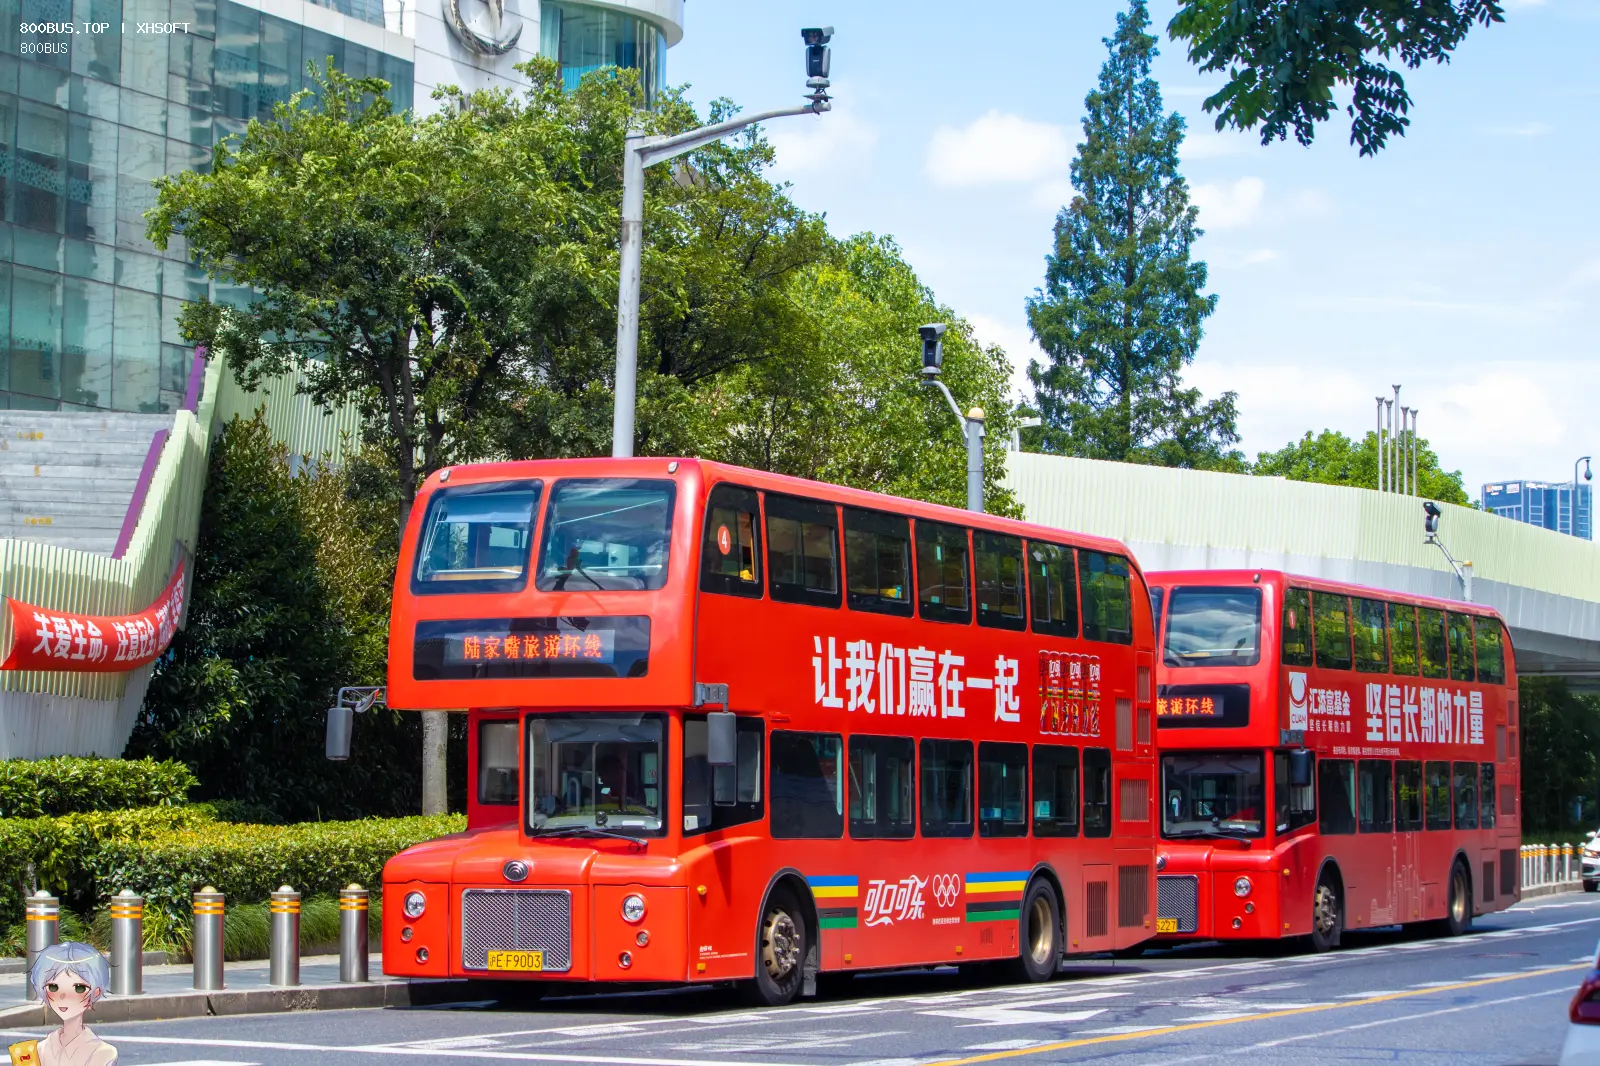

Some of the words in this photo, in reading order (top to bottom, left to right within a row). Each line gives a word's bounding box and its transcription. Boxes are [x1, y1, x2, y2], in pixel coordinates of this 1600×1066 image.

[721, 530, 728, 549] 4
[463, 633, 603, 660] 陆家嘴旅游环线
[812, 635, 1021, 723] 让我们赢在一起
[1309, 687, 1351, 716] 汇添富基金
[1365, 682, 1485, 745] 坚信长期的力量
[864, 874, 930, 927] 可口可乐
